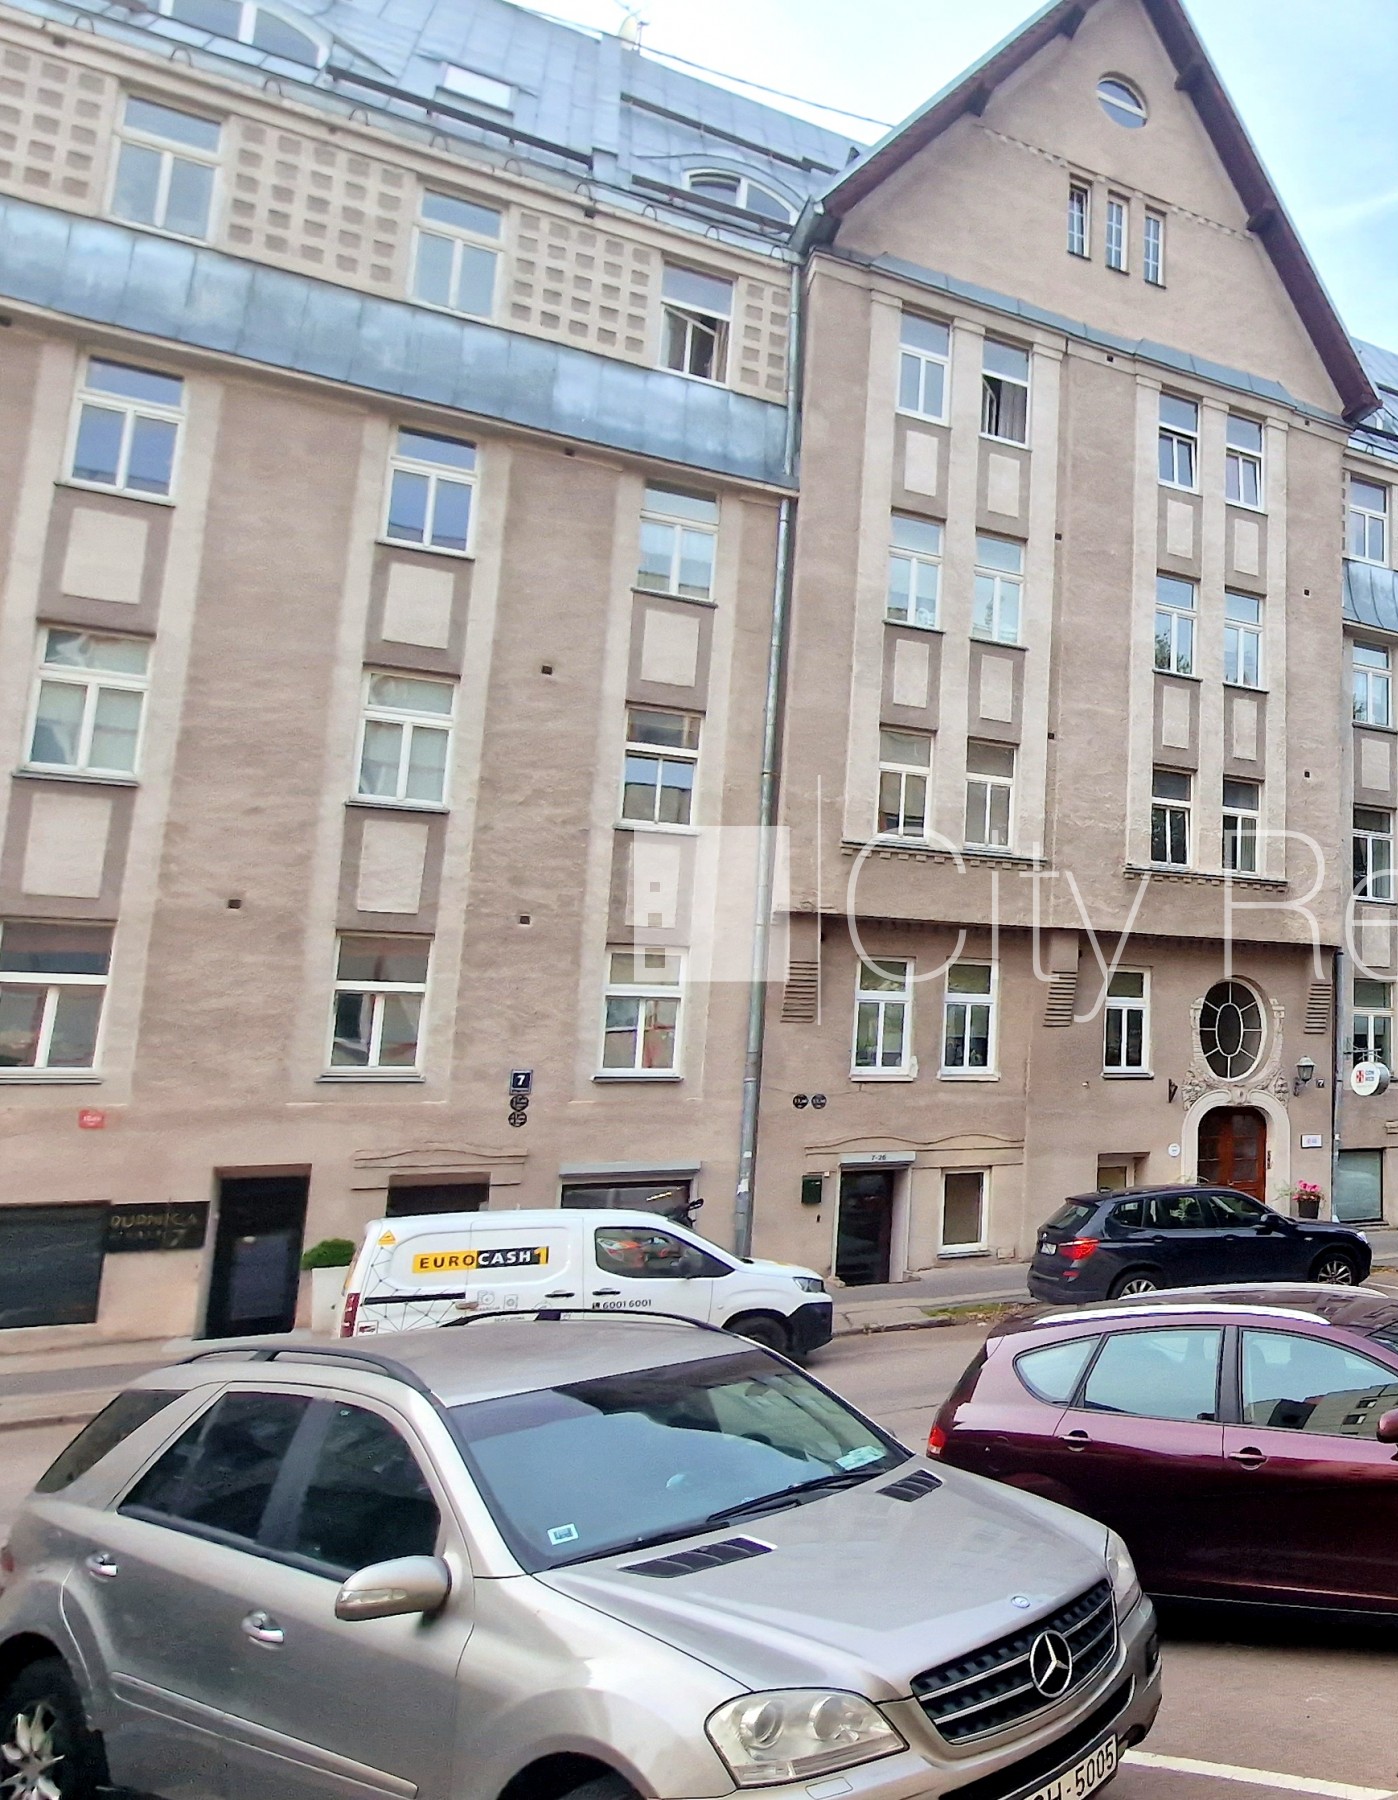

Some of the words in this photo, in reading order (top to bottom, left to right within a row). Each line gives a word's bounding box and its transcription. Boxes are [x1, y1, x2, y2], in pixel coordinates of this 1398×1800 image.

[517, 1074, 526, 1086] 7
[419, 1245, 548, 1270] EUROCASH1
[1033, 1739, 1115, 1800] H-5005
